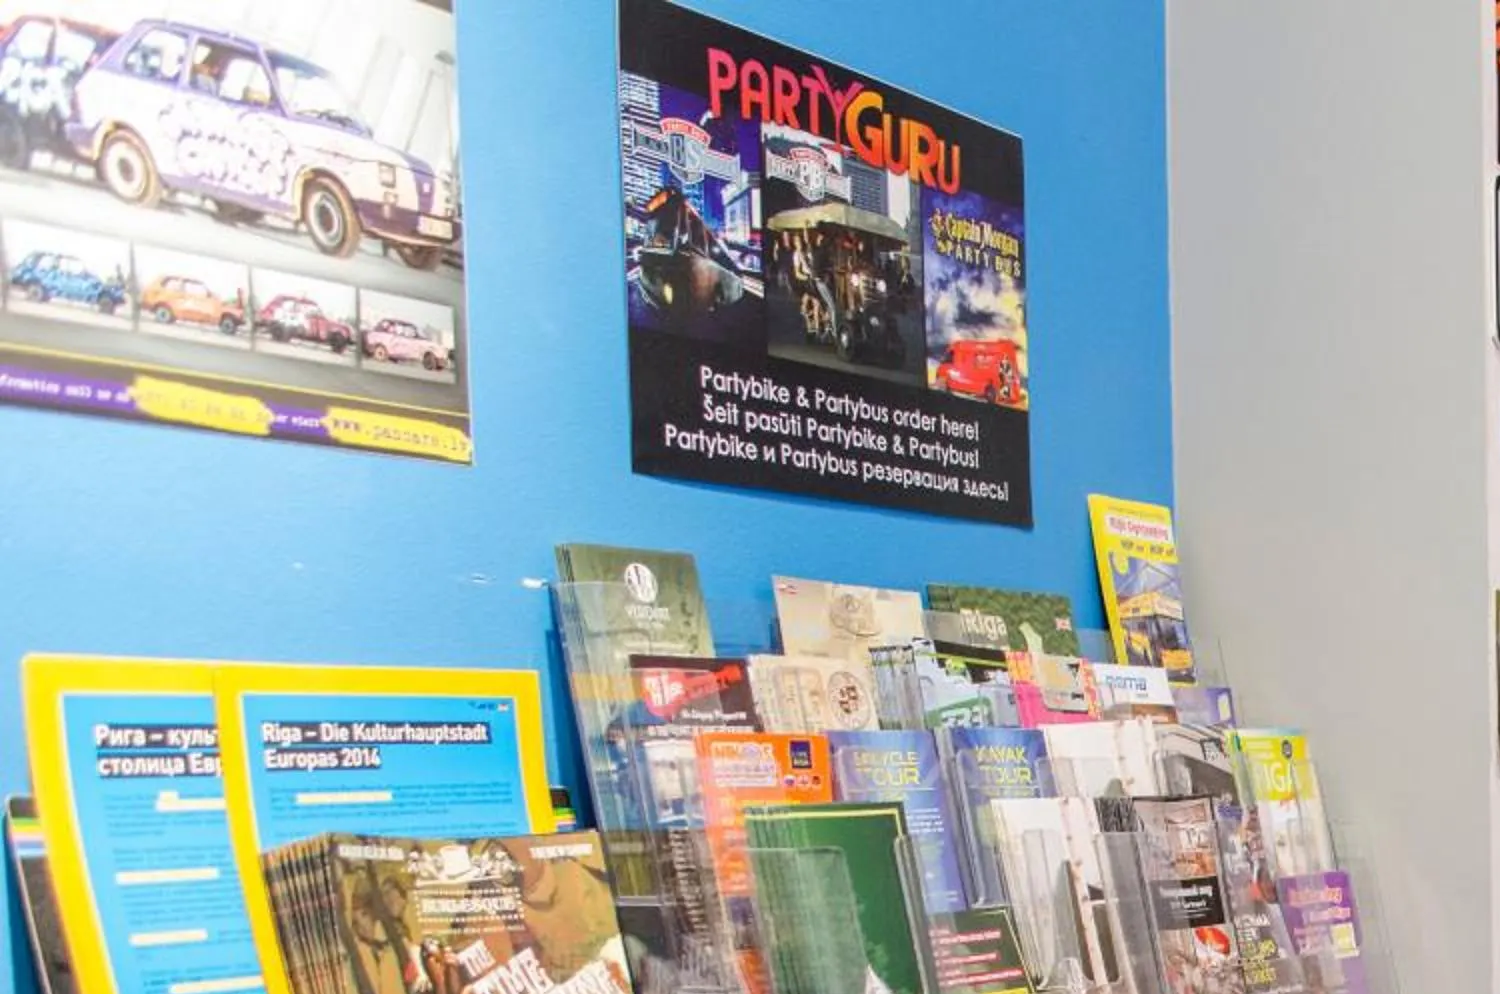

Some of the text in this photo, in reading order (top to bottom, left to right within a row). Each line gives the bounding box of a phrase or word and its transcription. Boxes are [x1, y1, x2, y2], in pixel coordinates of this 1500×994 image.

[700, 365, 979, 441] Partybike & Partybus order here!
[703, 393, 979, 469] Šeit pasūti Partybike & Partybus!
[664, 423, 1009, 502] Partybike и Partybus резервация здесь!
[95, 724, 147, 746] Рига
[261, 722, 302, 746] Riga
[320, 723, 349, 741] Die
[353, 722, 488, 745] Kulturhauptstadt
[98, 756, 186, 777] столица
[265, 748, 382, 771] Europas 2014
